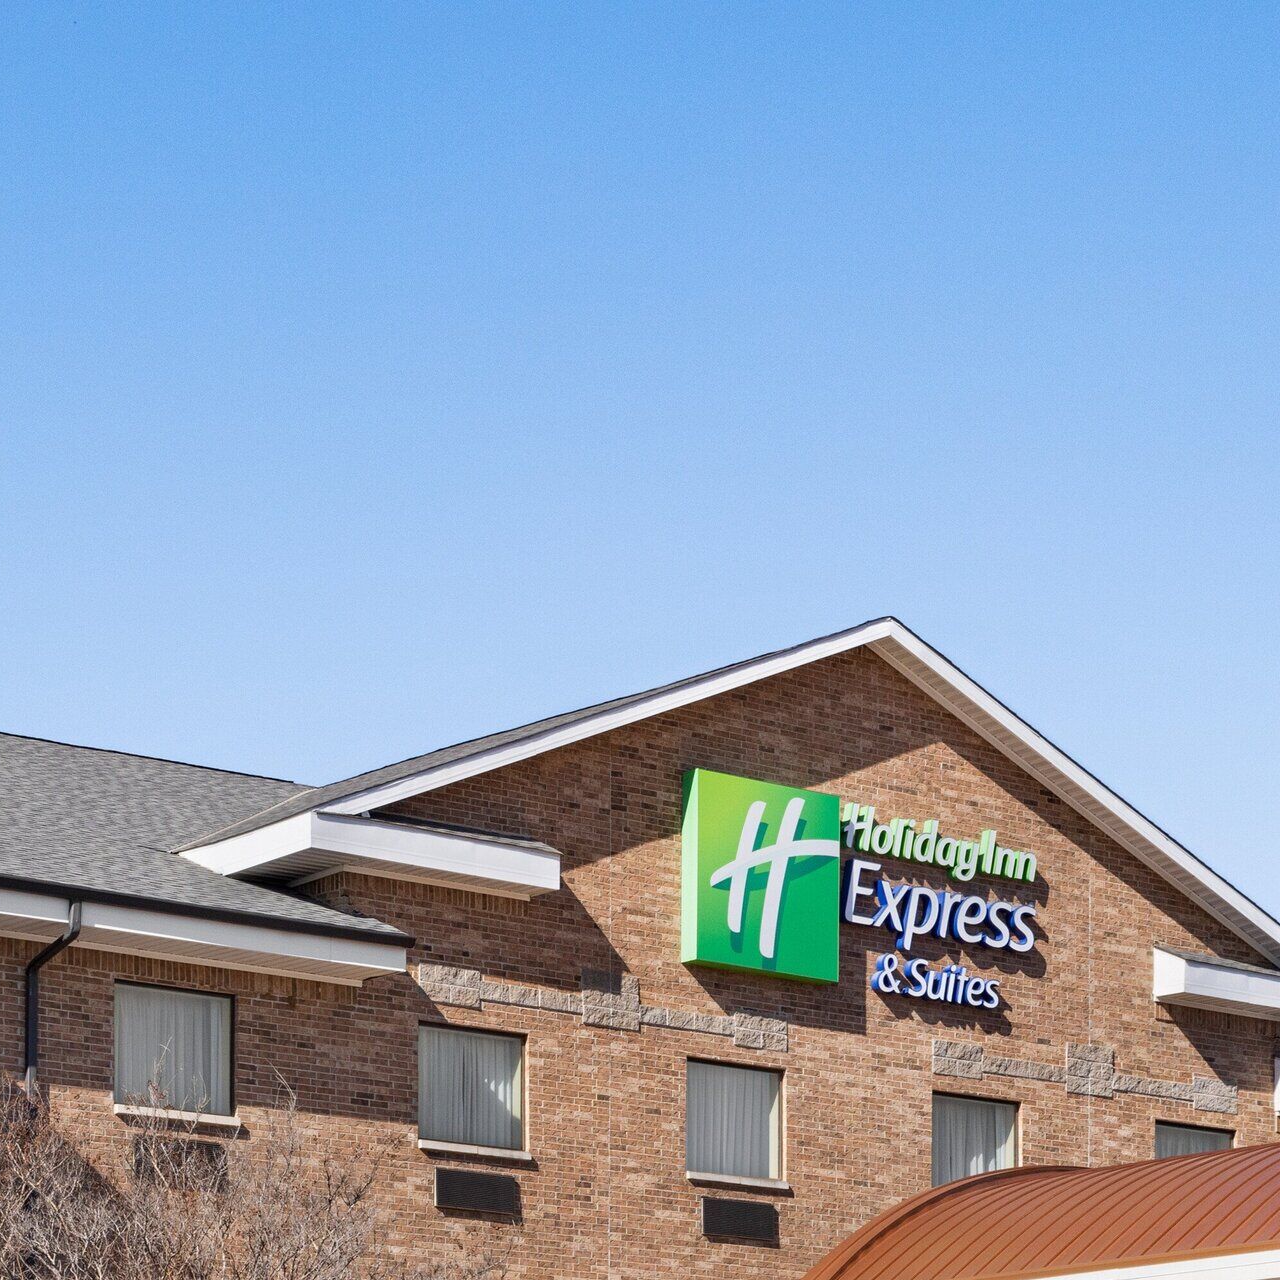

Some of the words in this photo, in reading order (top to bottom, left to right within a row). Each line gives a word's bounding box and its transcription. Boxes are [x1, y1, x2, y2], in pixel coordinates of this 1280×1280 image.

[843, 803, 979, 881] Holiday
[979, 829, 1037, 882] Inn
[845, 859, 1036, 952] Express
[875, 953, 901, 994] &
[905, 958, 1000, 1009] Suites
